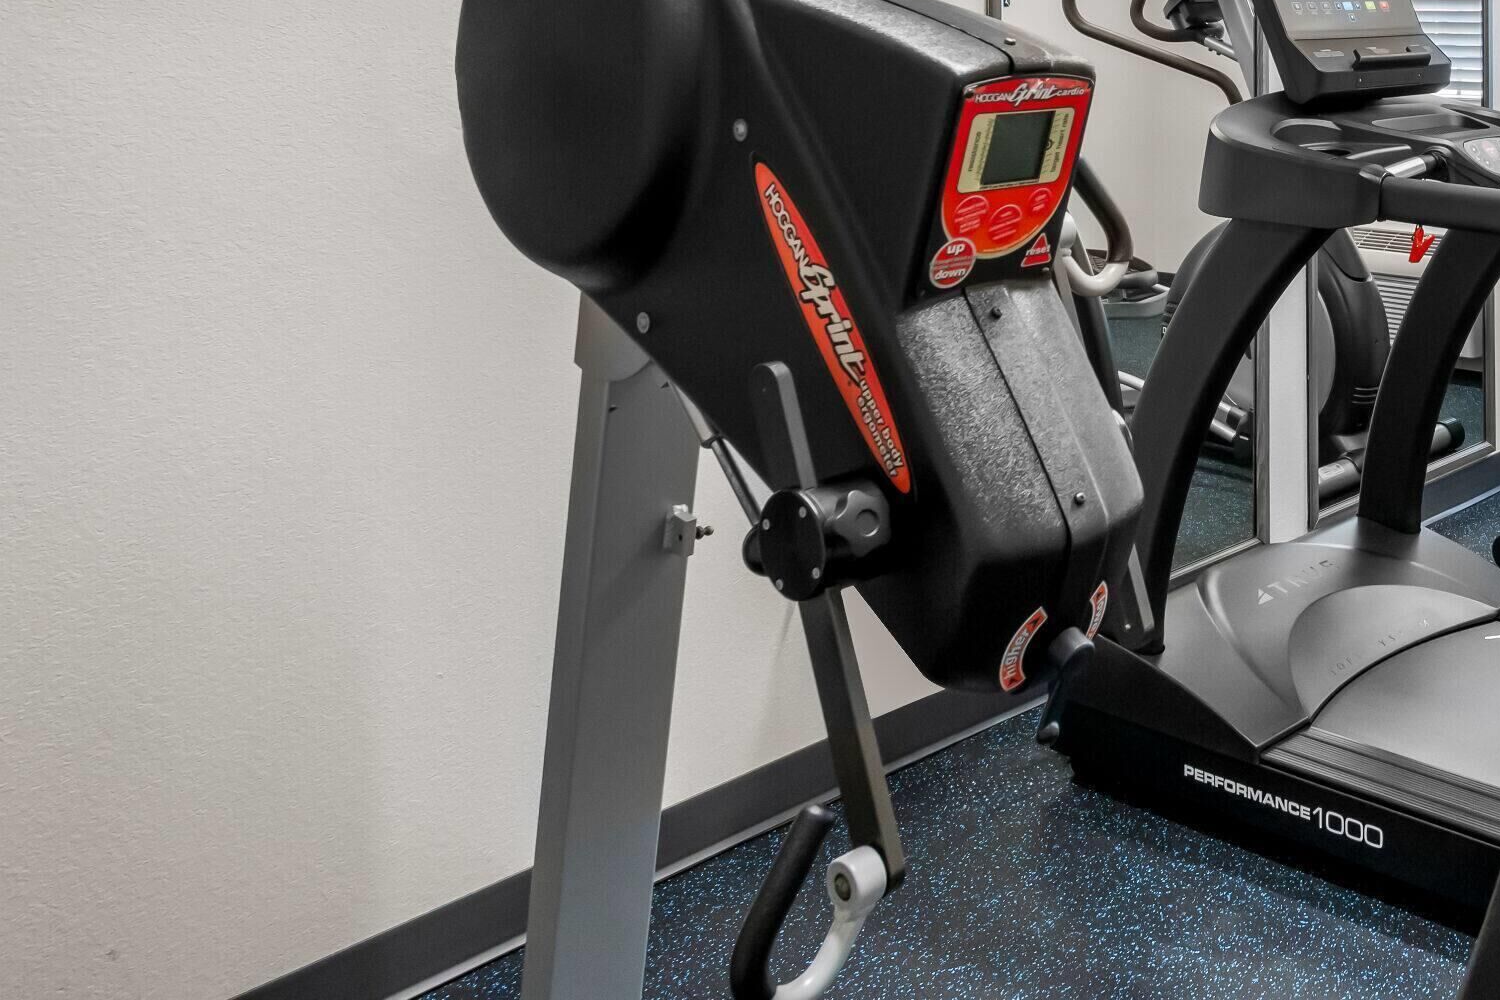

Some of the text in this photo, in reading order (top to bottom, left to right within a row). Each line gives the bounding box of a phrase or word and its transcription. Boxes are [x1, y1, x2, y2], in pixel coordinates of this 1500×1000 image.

[1056, 88, 1084, 97] cardio
[934, 268, 966, 280] down
[946, 243, 966, 256] up
[1025, 244, 1051, 256] reset
[765, 184, 866, 384] HOGGAN Sprint
[858, 397, 897, 476] ergometer
[860, 380, 903, 467] upper body
[1005, 628, 1030, 679] higher
[1184, 764, 1384, 849] PERFORMANCE 1000
